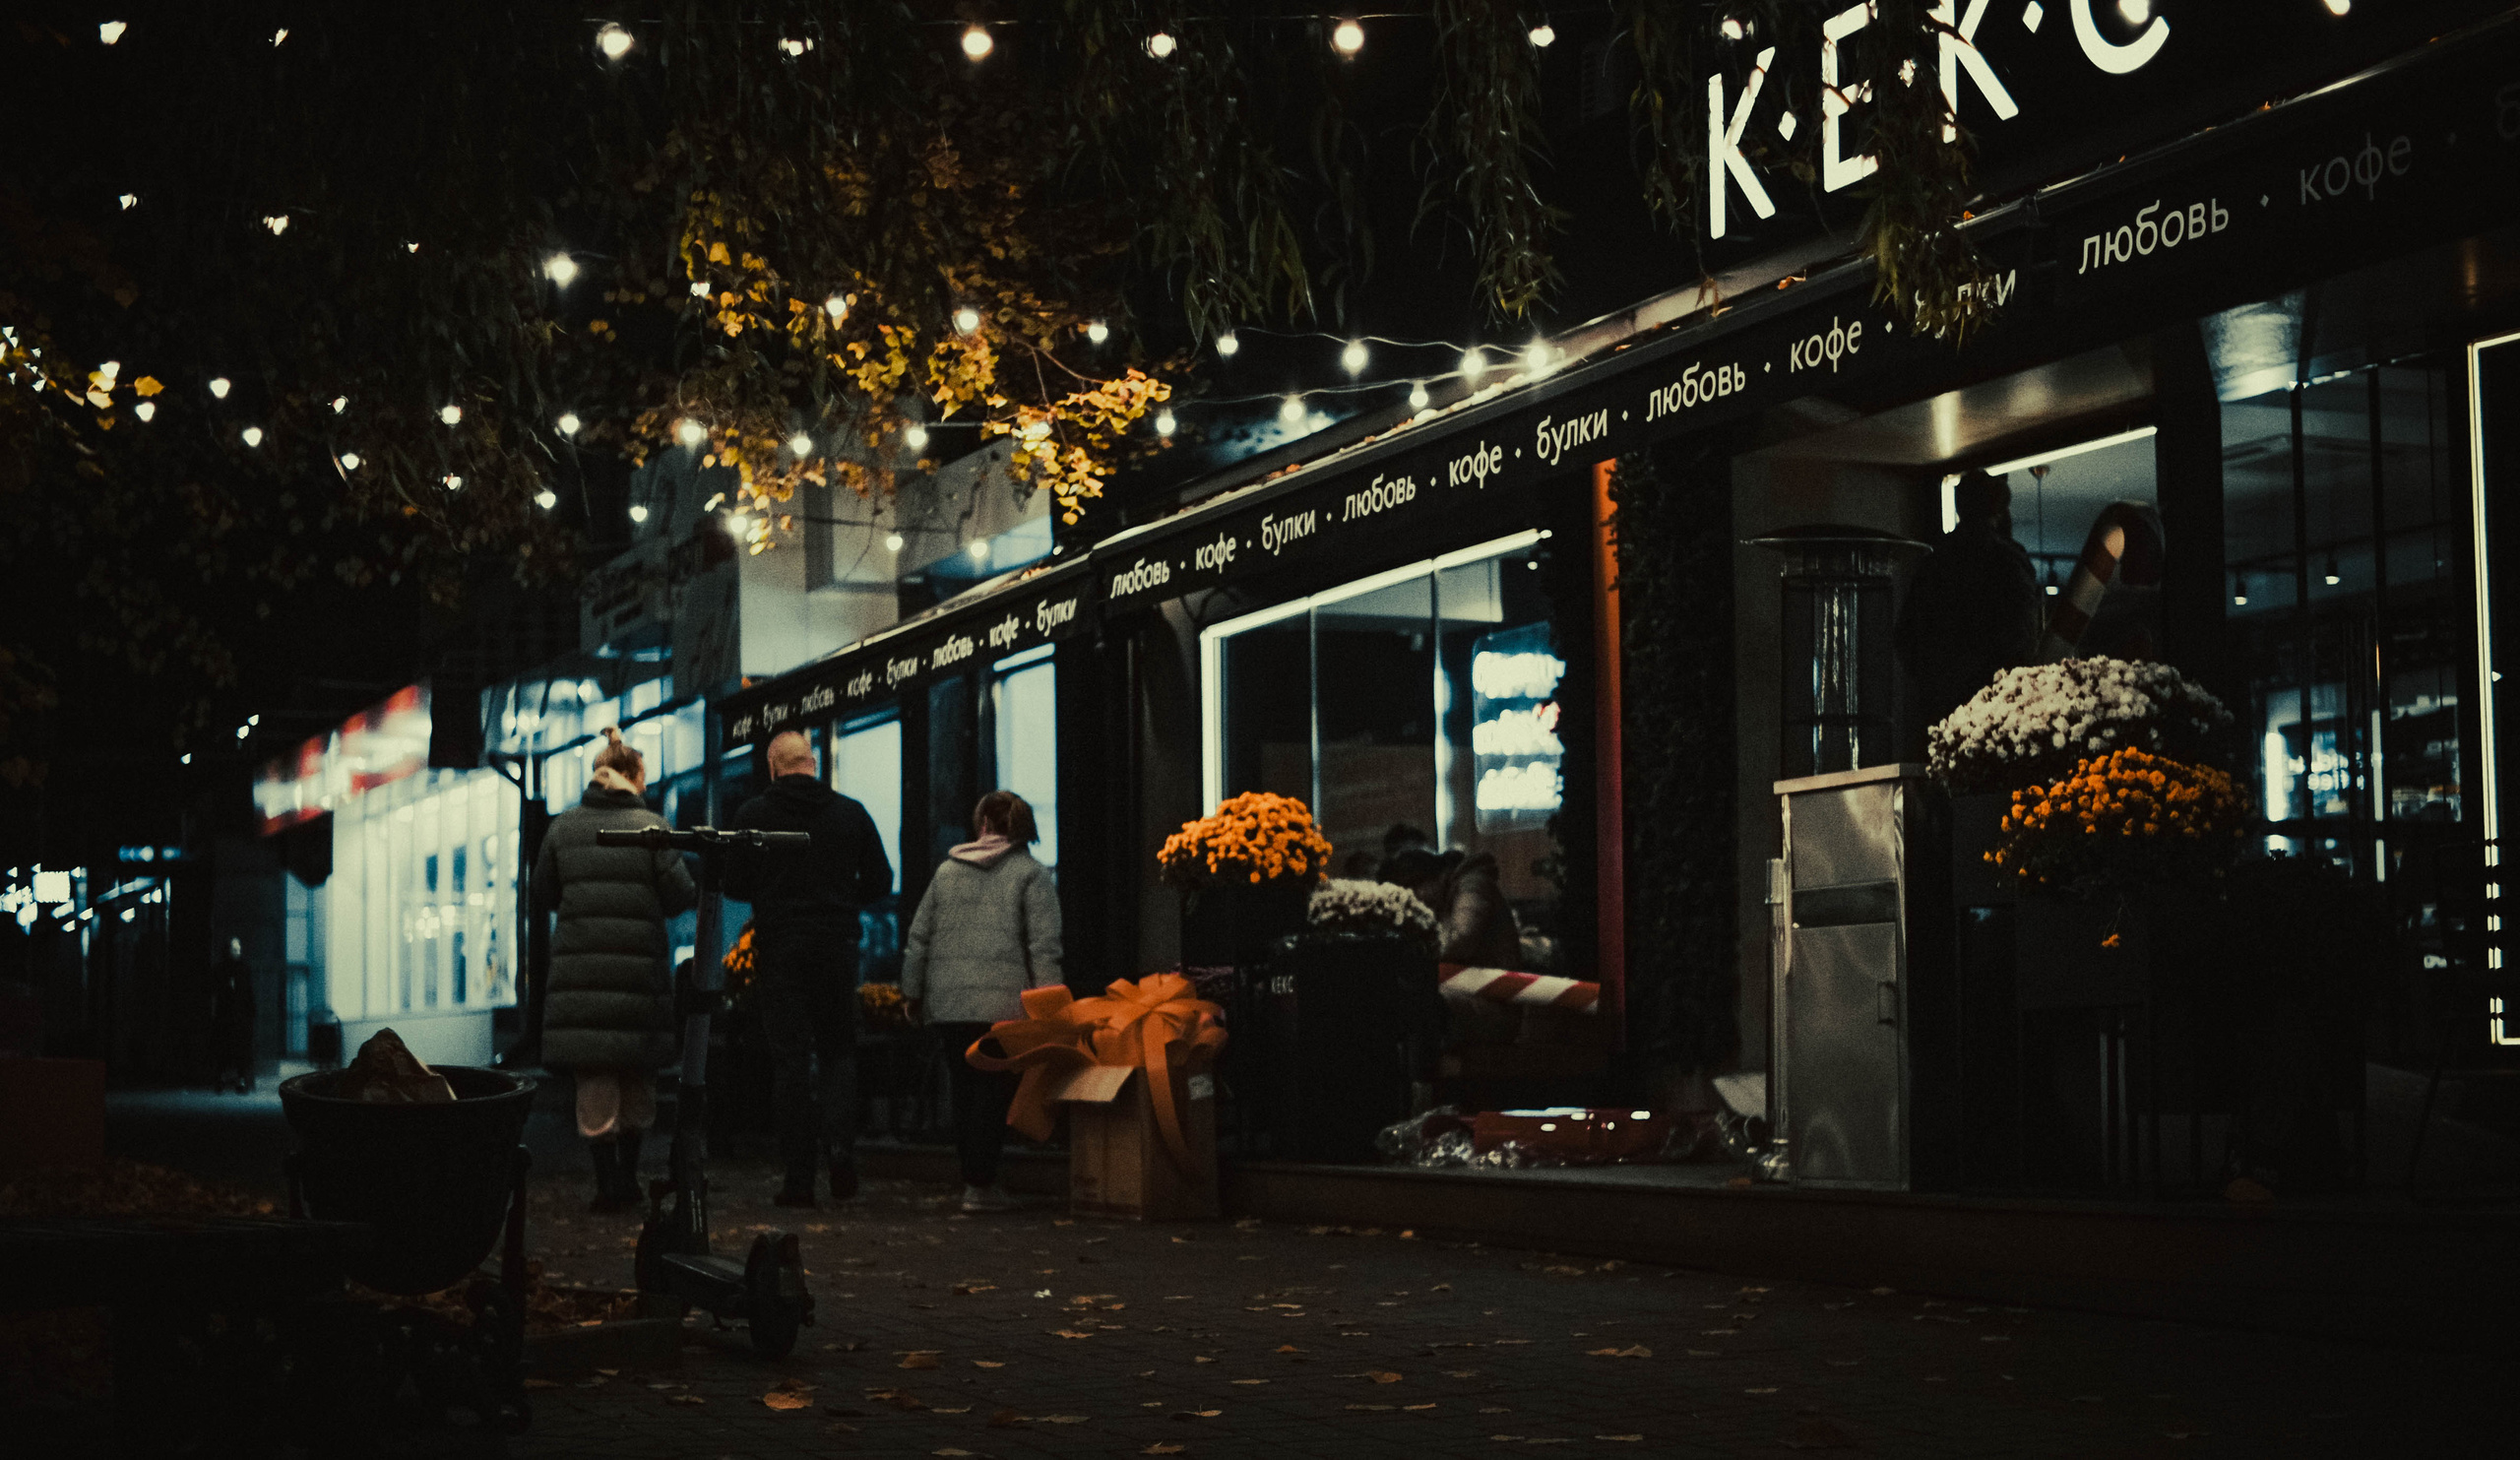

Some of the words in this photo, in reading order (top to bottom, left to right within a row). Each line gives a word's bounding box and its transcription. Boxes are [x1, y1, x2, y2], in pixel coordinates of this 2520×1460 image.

[2078, 198, 2230, 276] любовь
[2300, 132, 2412, 206] кофе
[1109, 556, 1171, 600] любовь
[1195, 532, 1237, 574] кофе
[1261, 509, 1316, 556] булки
[1342, 473, 1417, 522] любовь
[1448, 440, 1503, 489] кофе
[1536, 414, 1608, 467] булки
[1645, 361, 1746, 422] любовь
[1790, 315, 1862, 373] кофе
[886, 657, 918, 689] булки
[931, 633, 975, 670] любовь
[989, 613, 1020, 650] кофе
[1037, 598, 1078, 637] булки
